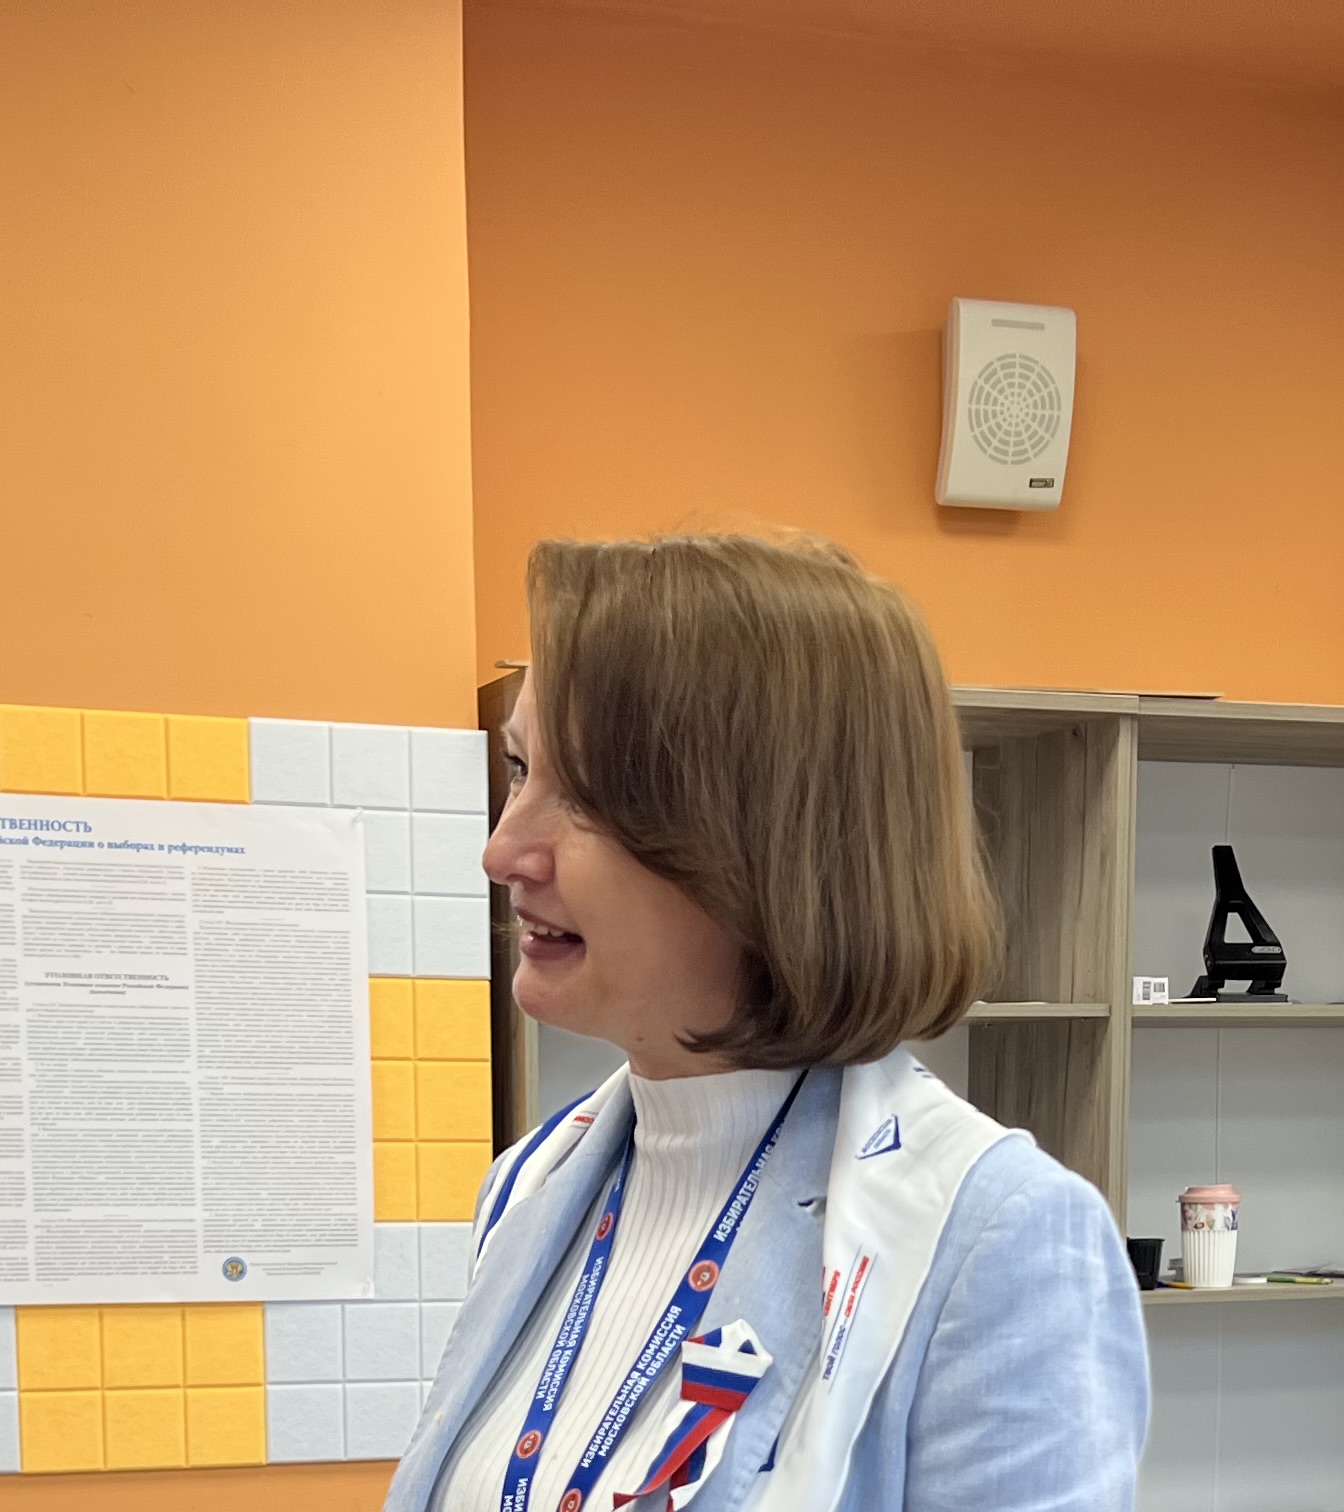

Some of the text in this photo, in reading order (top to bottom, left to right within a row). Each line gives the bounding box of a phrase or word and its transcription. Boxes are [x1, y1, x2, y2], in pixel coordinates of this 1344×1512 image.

[536, 1274, 590, 1401] МОСКОВСКОЙ ОБЛАСТИ
[542, 1256, 605, 1412] ИЗБИРАТЕЛЬНАЯ КОМИССИЯ
[581, 1305, 682, 1468] ИЗБИРАТЕЛЬНАЯ КОМИССИЯ
[598, 1324, 686, 1457] МОСКОВСКОЙ ОБЛАСТИ
